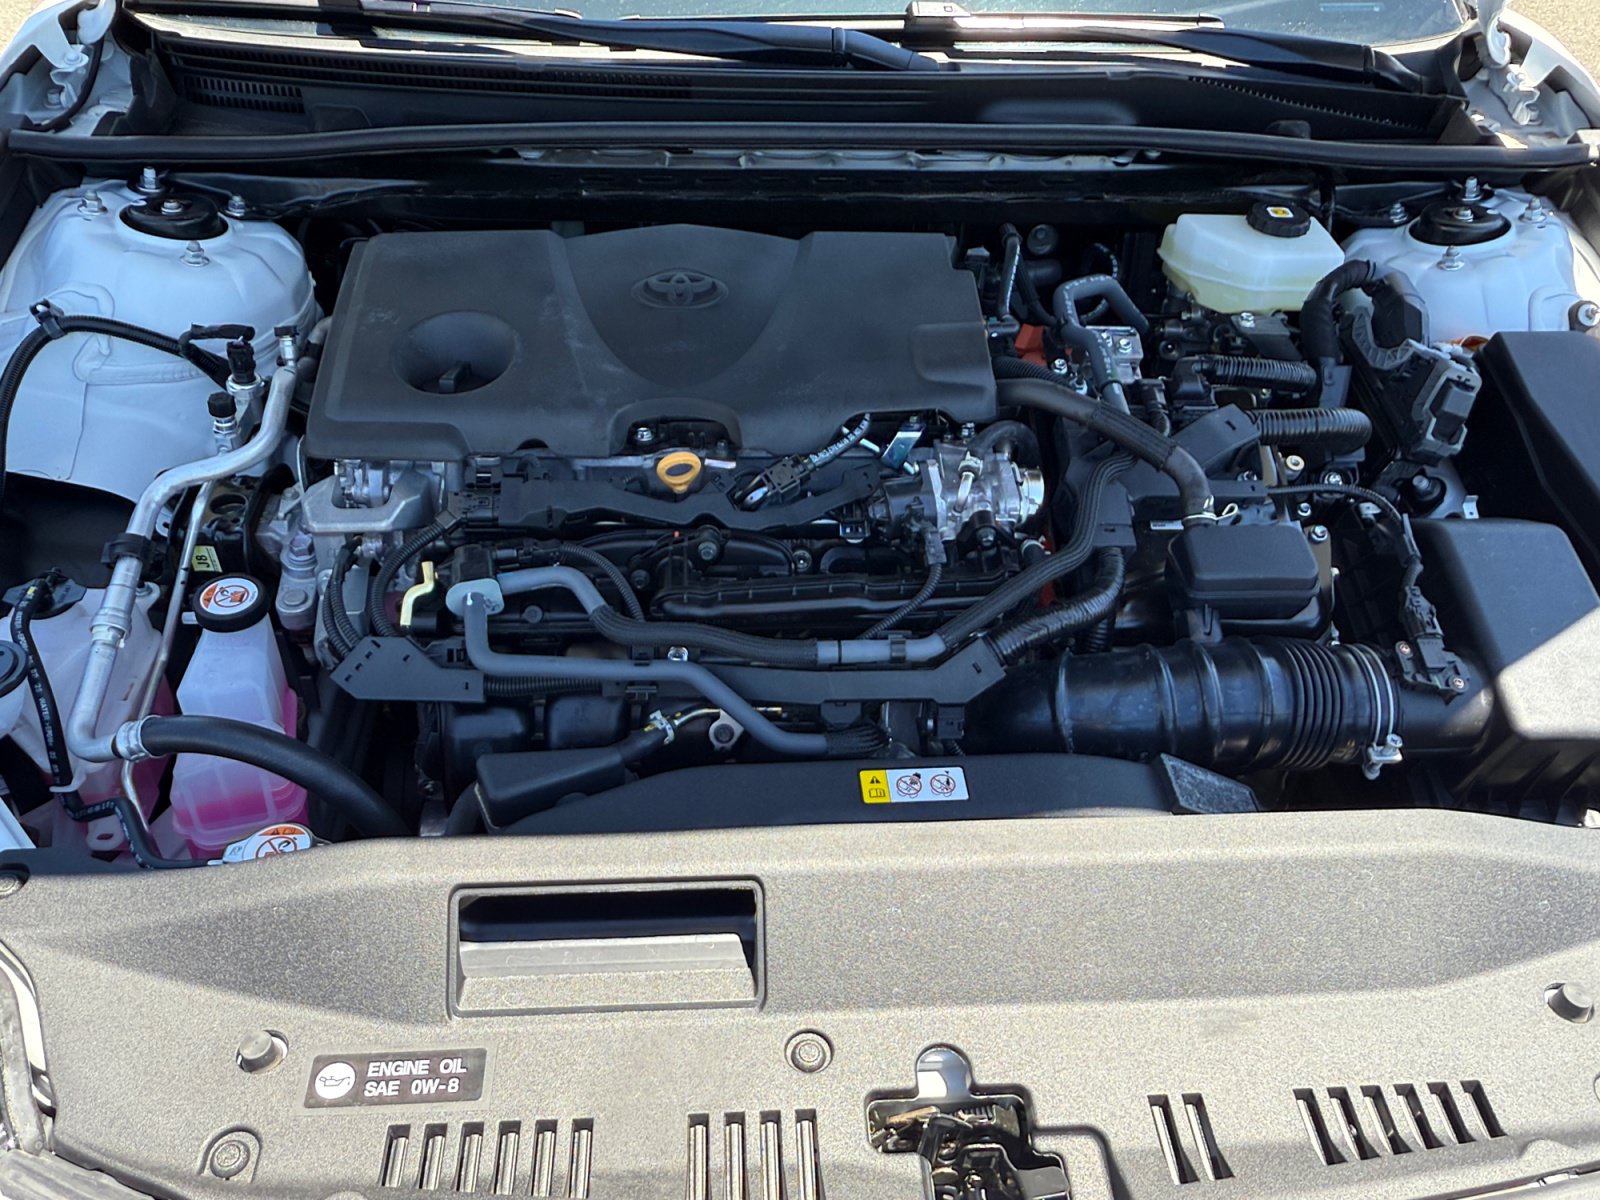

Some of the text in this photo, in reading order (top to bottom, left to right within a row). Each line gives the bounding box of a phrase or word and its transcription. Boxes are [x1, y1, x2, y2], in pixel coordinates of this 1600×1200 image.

[196, 554, 210, 568] J8
[367, 1058, 467, 1077] ENGINE OIL
[364, 1077, 459, 1097] SAE 0W-8
